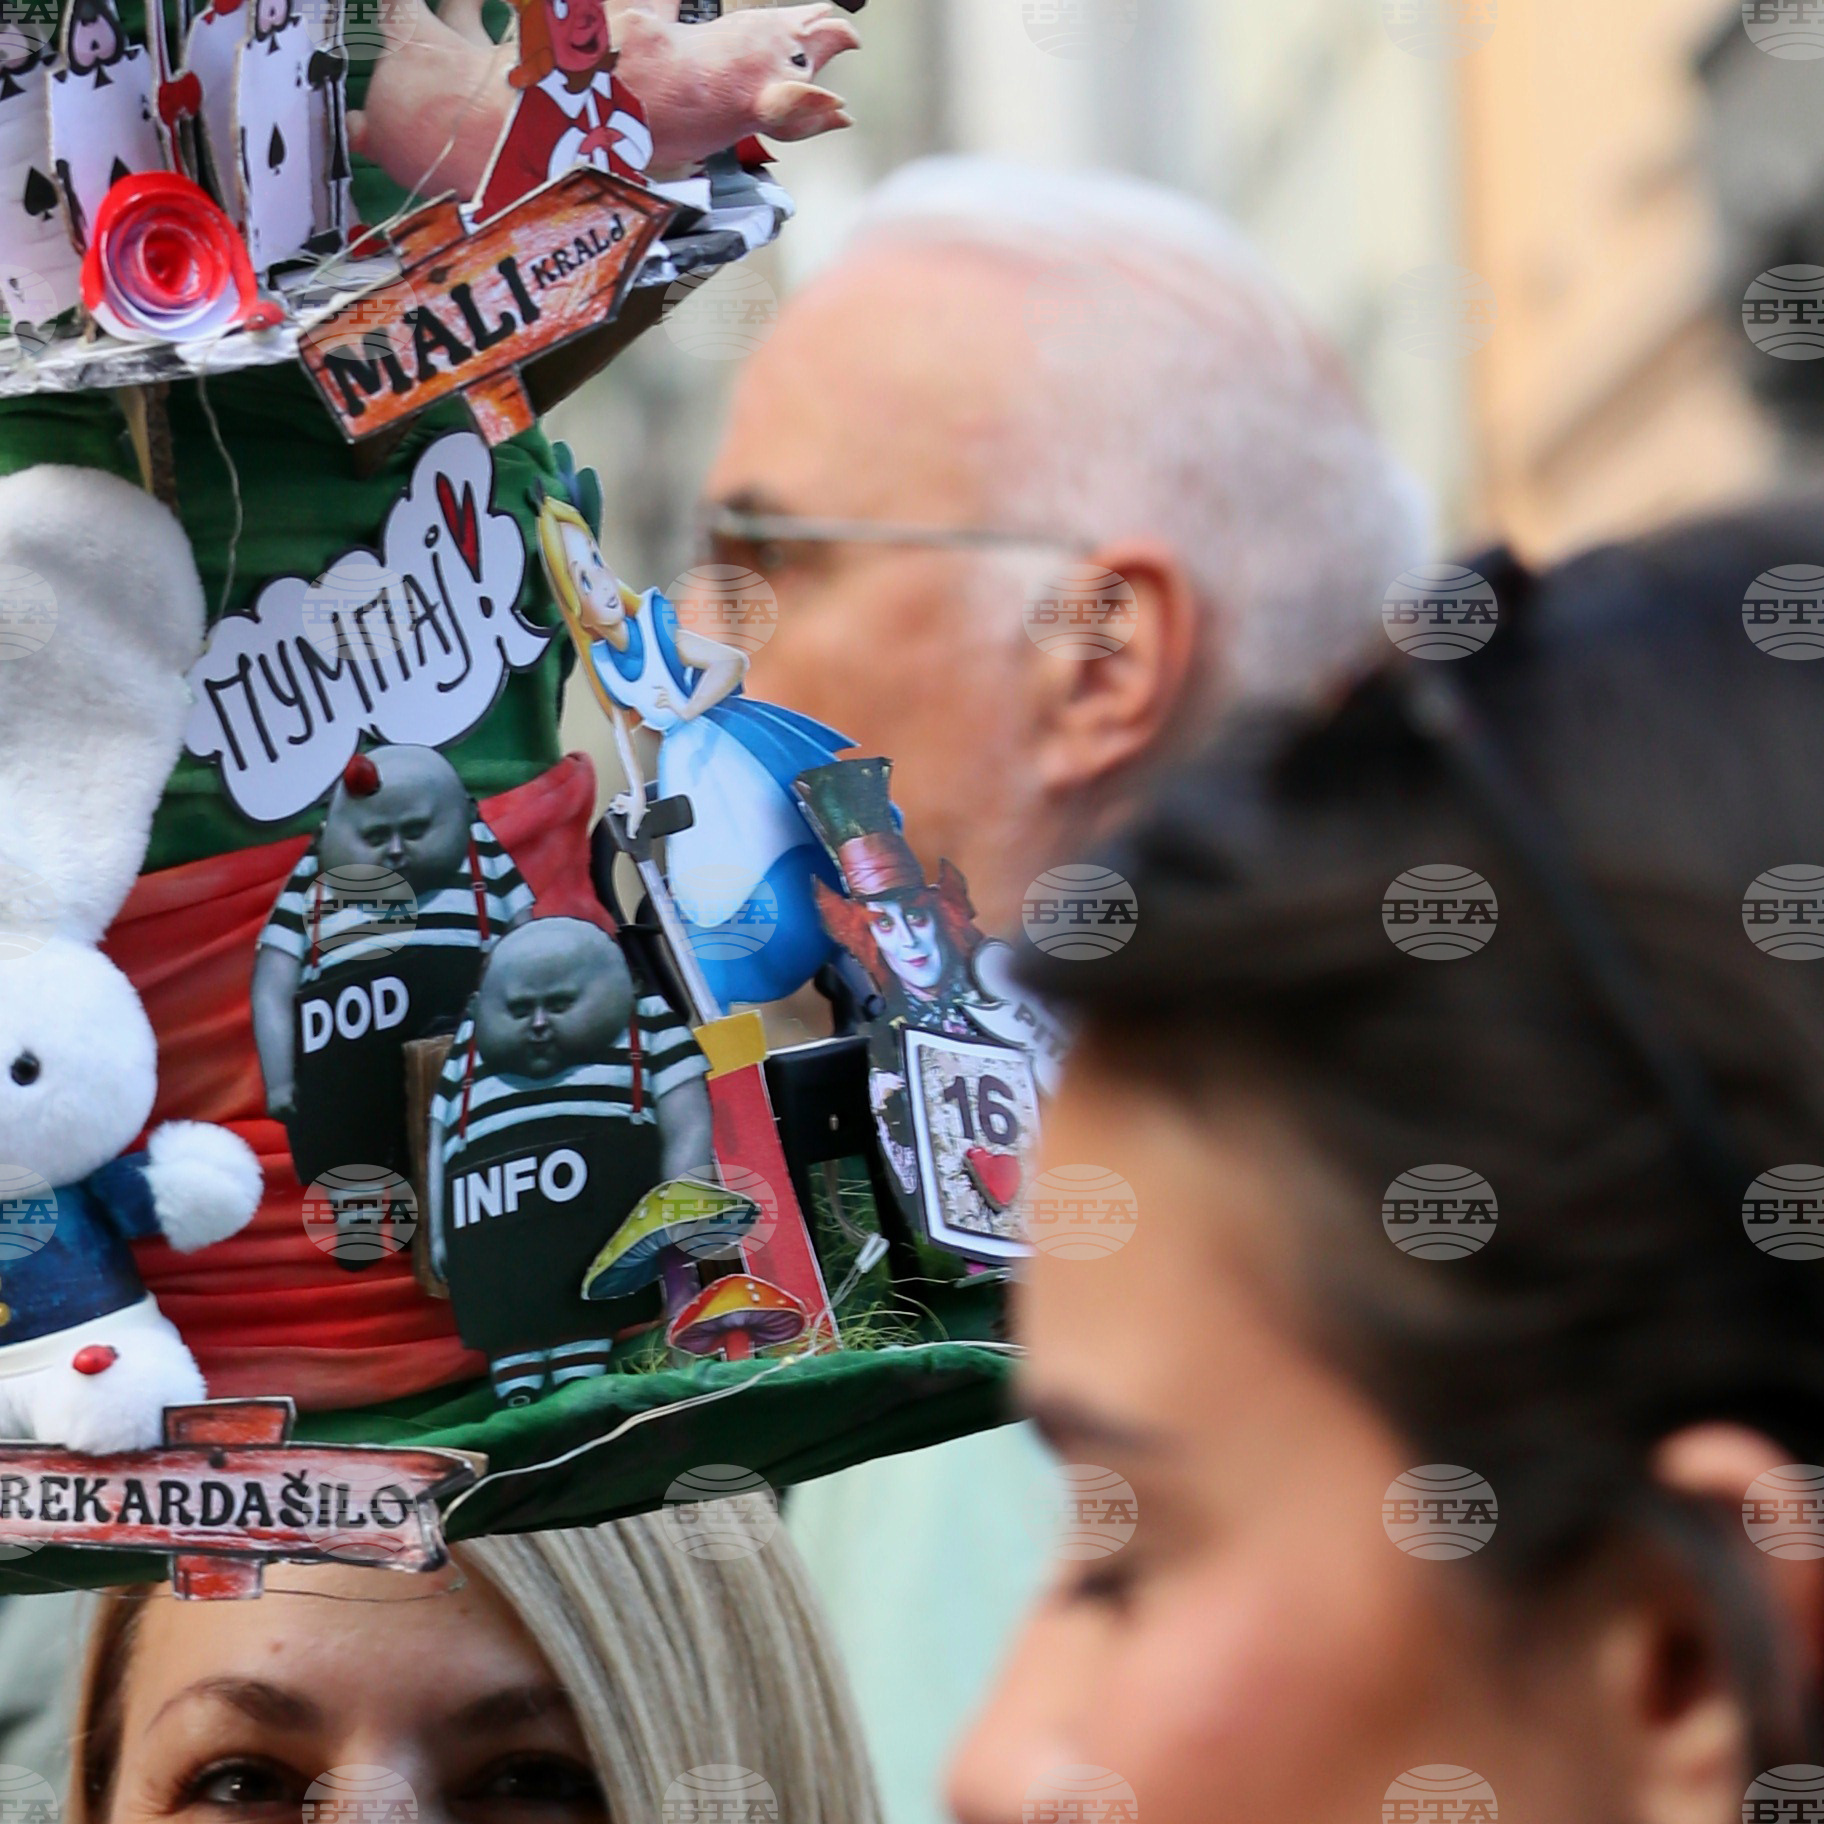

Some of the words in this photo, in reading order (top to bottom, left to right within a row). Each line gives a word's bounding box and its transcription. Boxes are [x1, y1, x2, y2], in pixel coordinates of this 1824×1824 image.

[323, 255, 541, 418] MALI
[302, 975, 410, 1053] DOD
[944, 1075, 1018, 1145] 16
[452, 1148, 588, 1228] INFO
